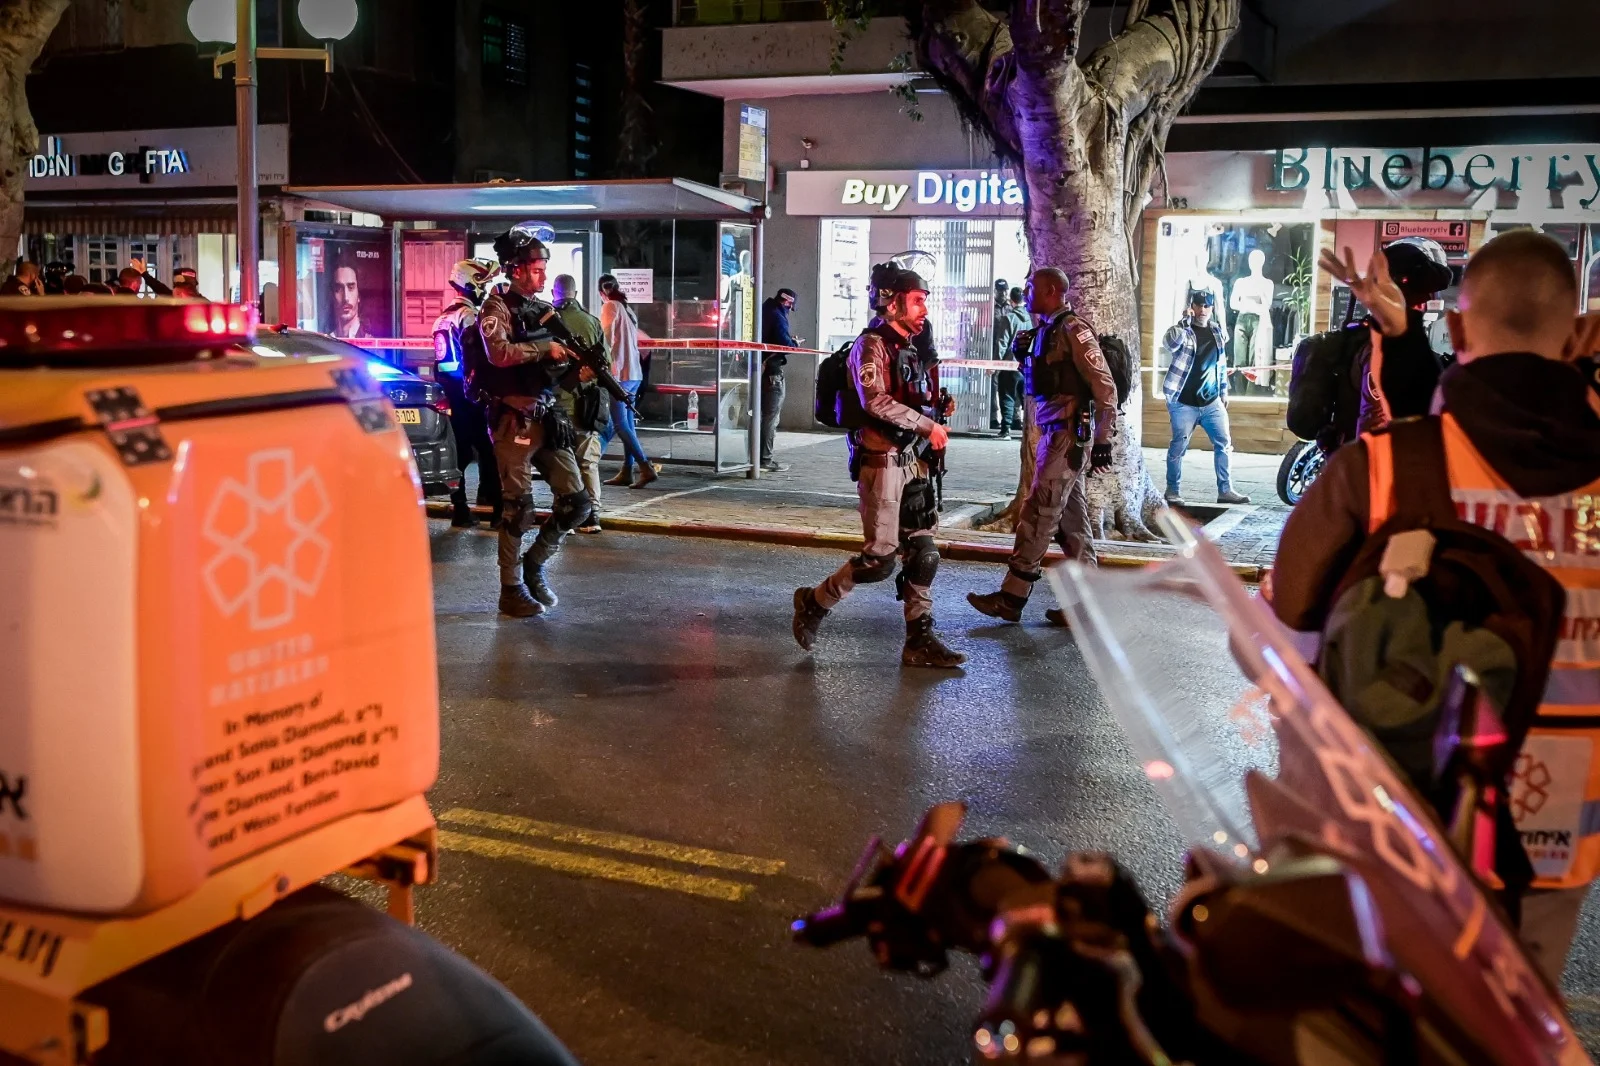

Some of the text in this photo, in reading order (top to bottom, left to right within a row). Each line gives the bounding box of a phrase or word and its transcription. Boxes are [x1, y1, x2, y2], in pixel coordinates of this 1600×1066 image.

[841, 172, 1024, 213] Buy Digita
[1266, 146, 1600, 208] Blueberry
